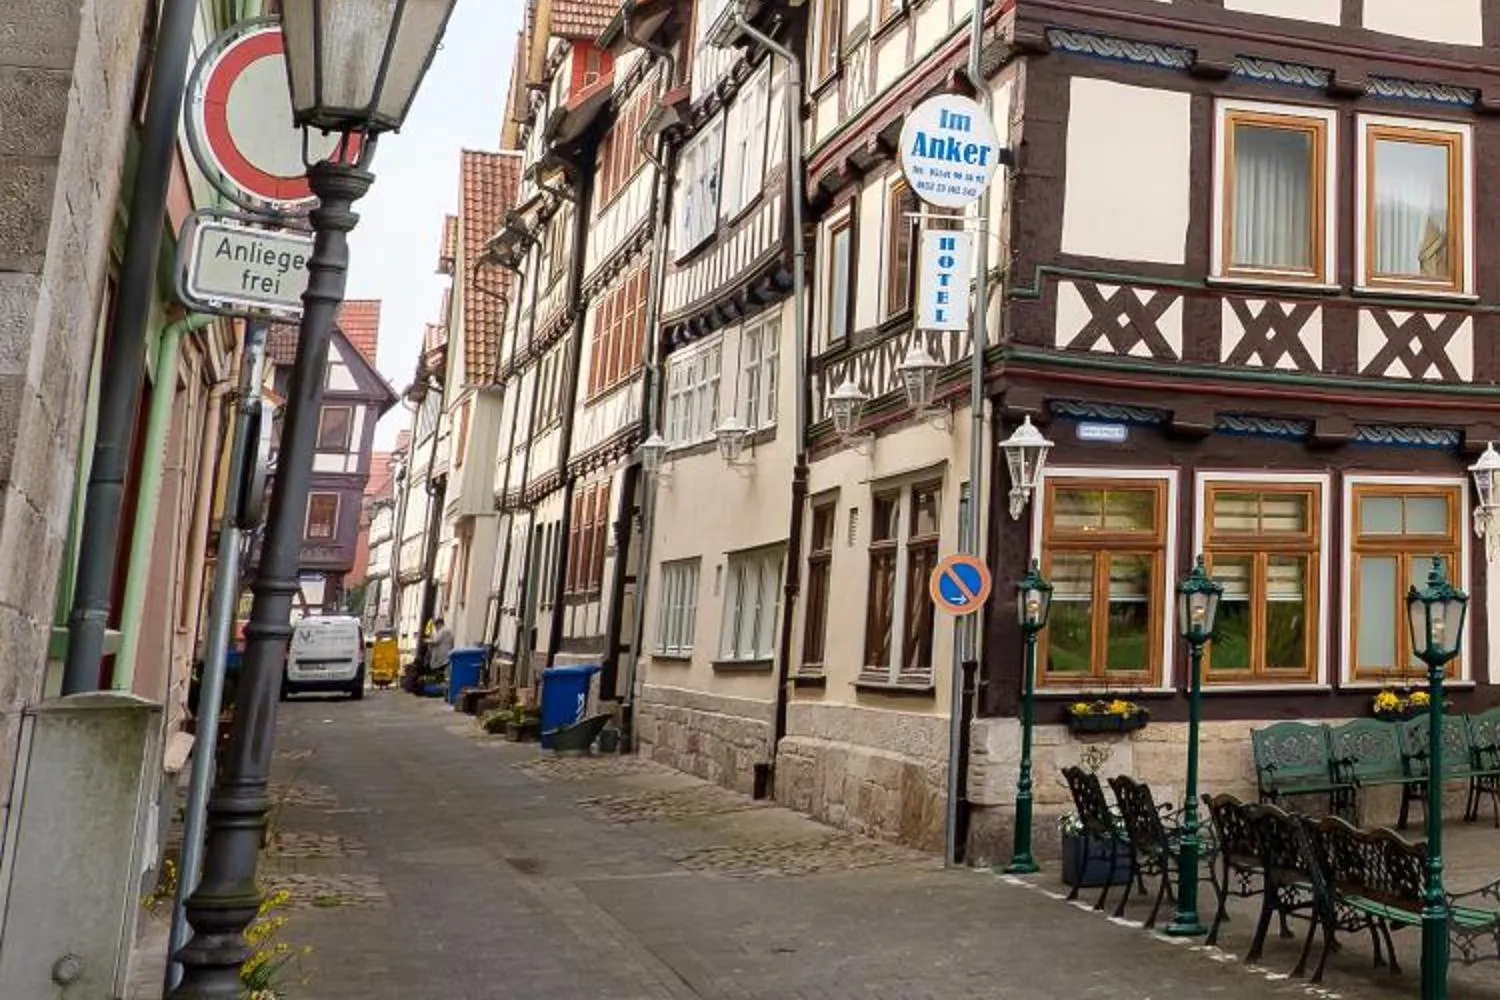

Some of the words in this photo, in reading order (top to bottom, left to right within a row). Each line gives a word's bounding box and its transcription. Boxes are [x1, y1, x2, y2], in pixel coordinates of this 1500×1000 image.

[939, 108, 971, 132] Im
[911, 131, 991, 167] Anker
[215, 236, 308, 274] Anliege
[240, 270, 281, 295] frei
[934, 237, 956, 323] HOTEL
